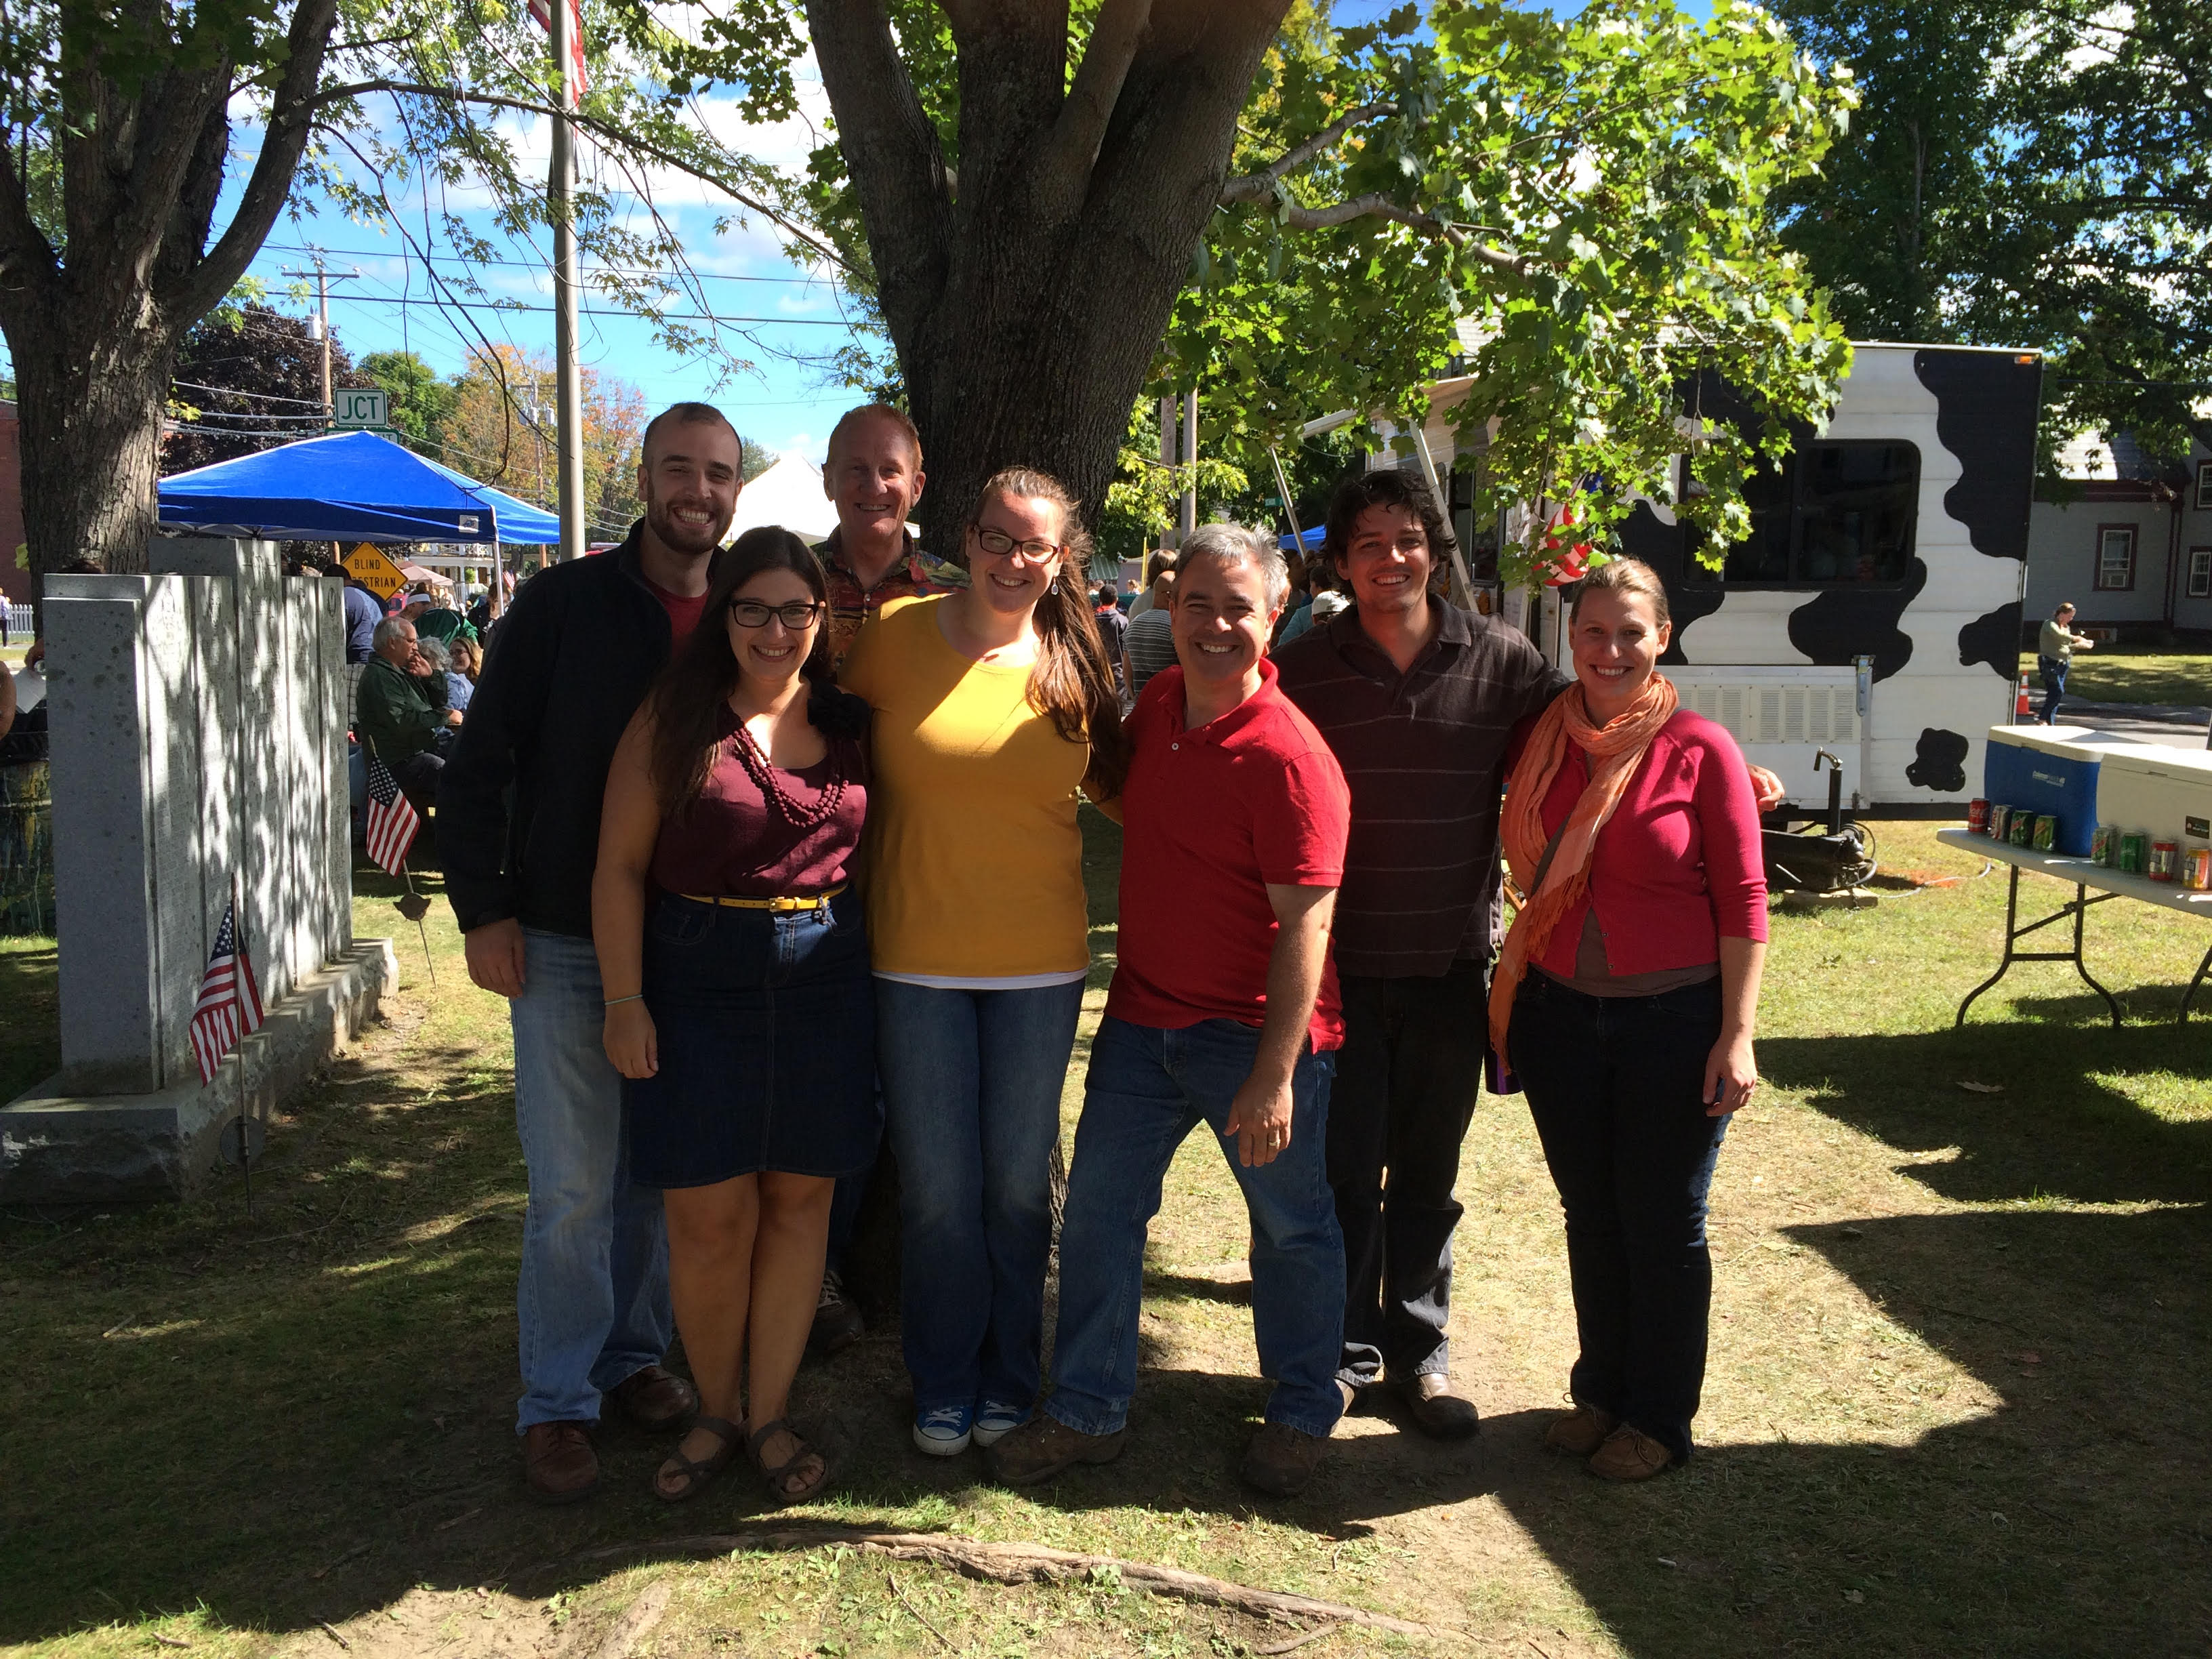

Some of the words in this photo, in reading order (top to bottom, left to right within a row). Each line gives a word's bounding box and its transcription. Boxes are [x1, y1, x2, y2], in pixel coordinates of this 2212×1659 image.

[341, 396, 379, 419] JCT
[354, 559, 380, 569] BLIND
[352, 577, 396, 588] STRIAN
